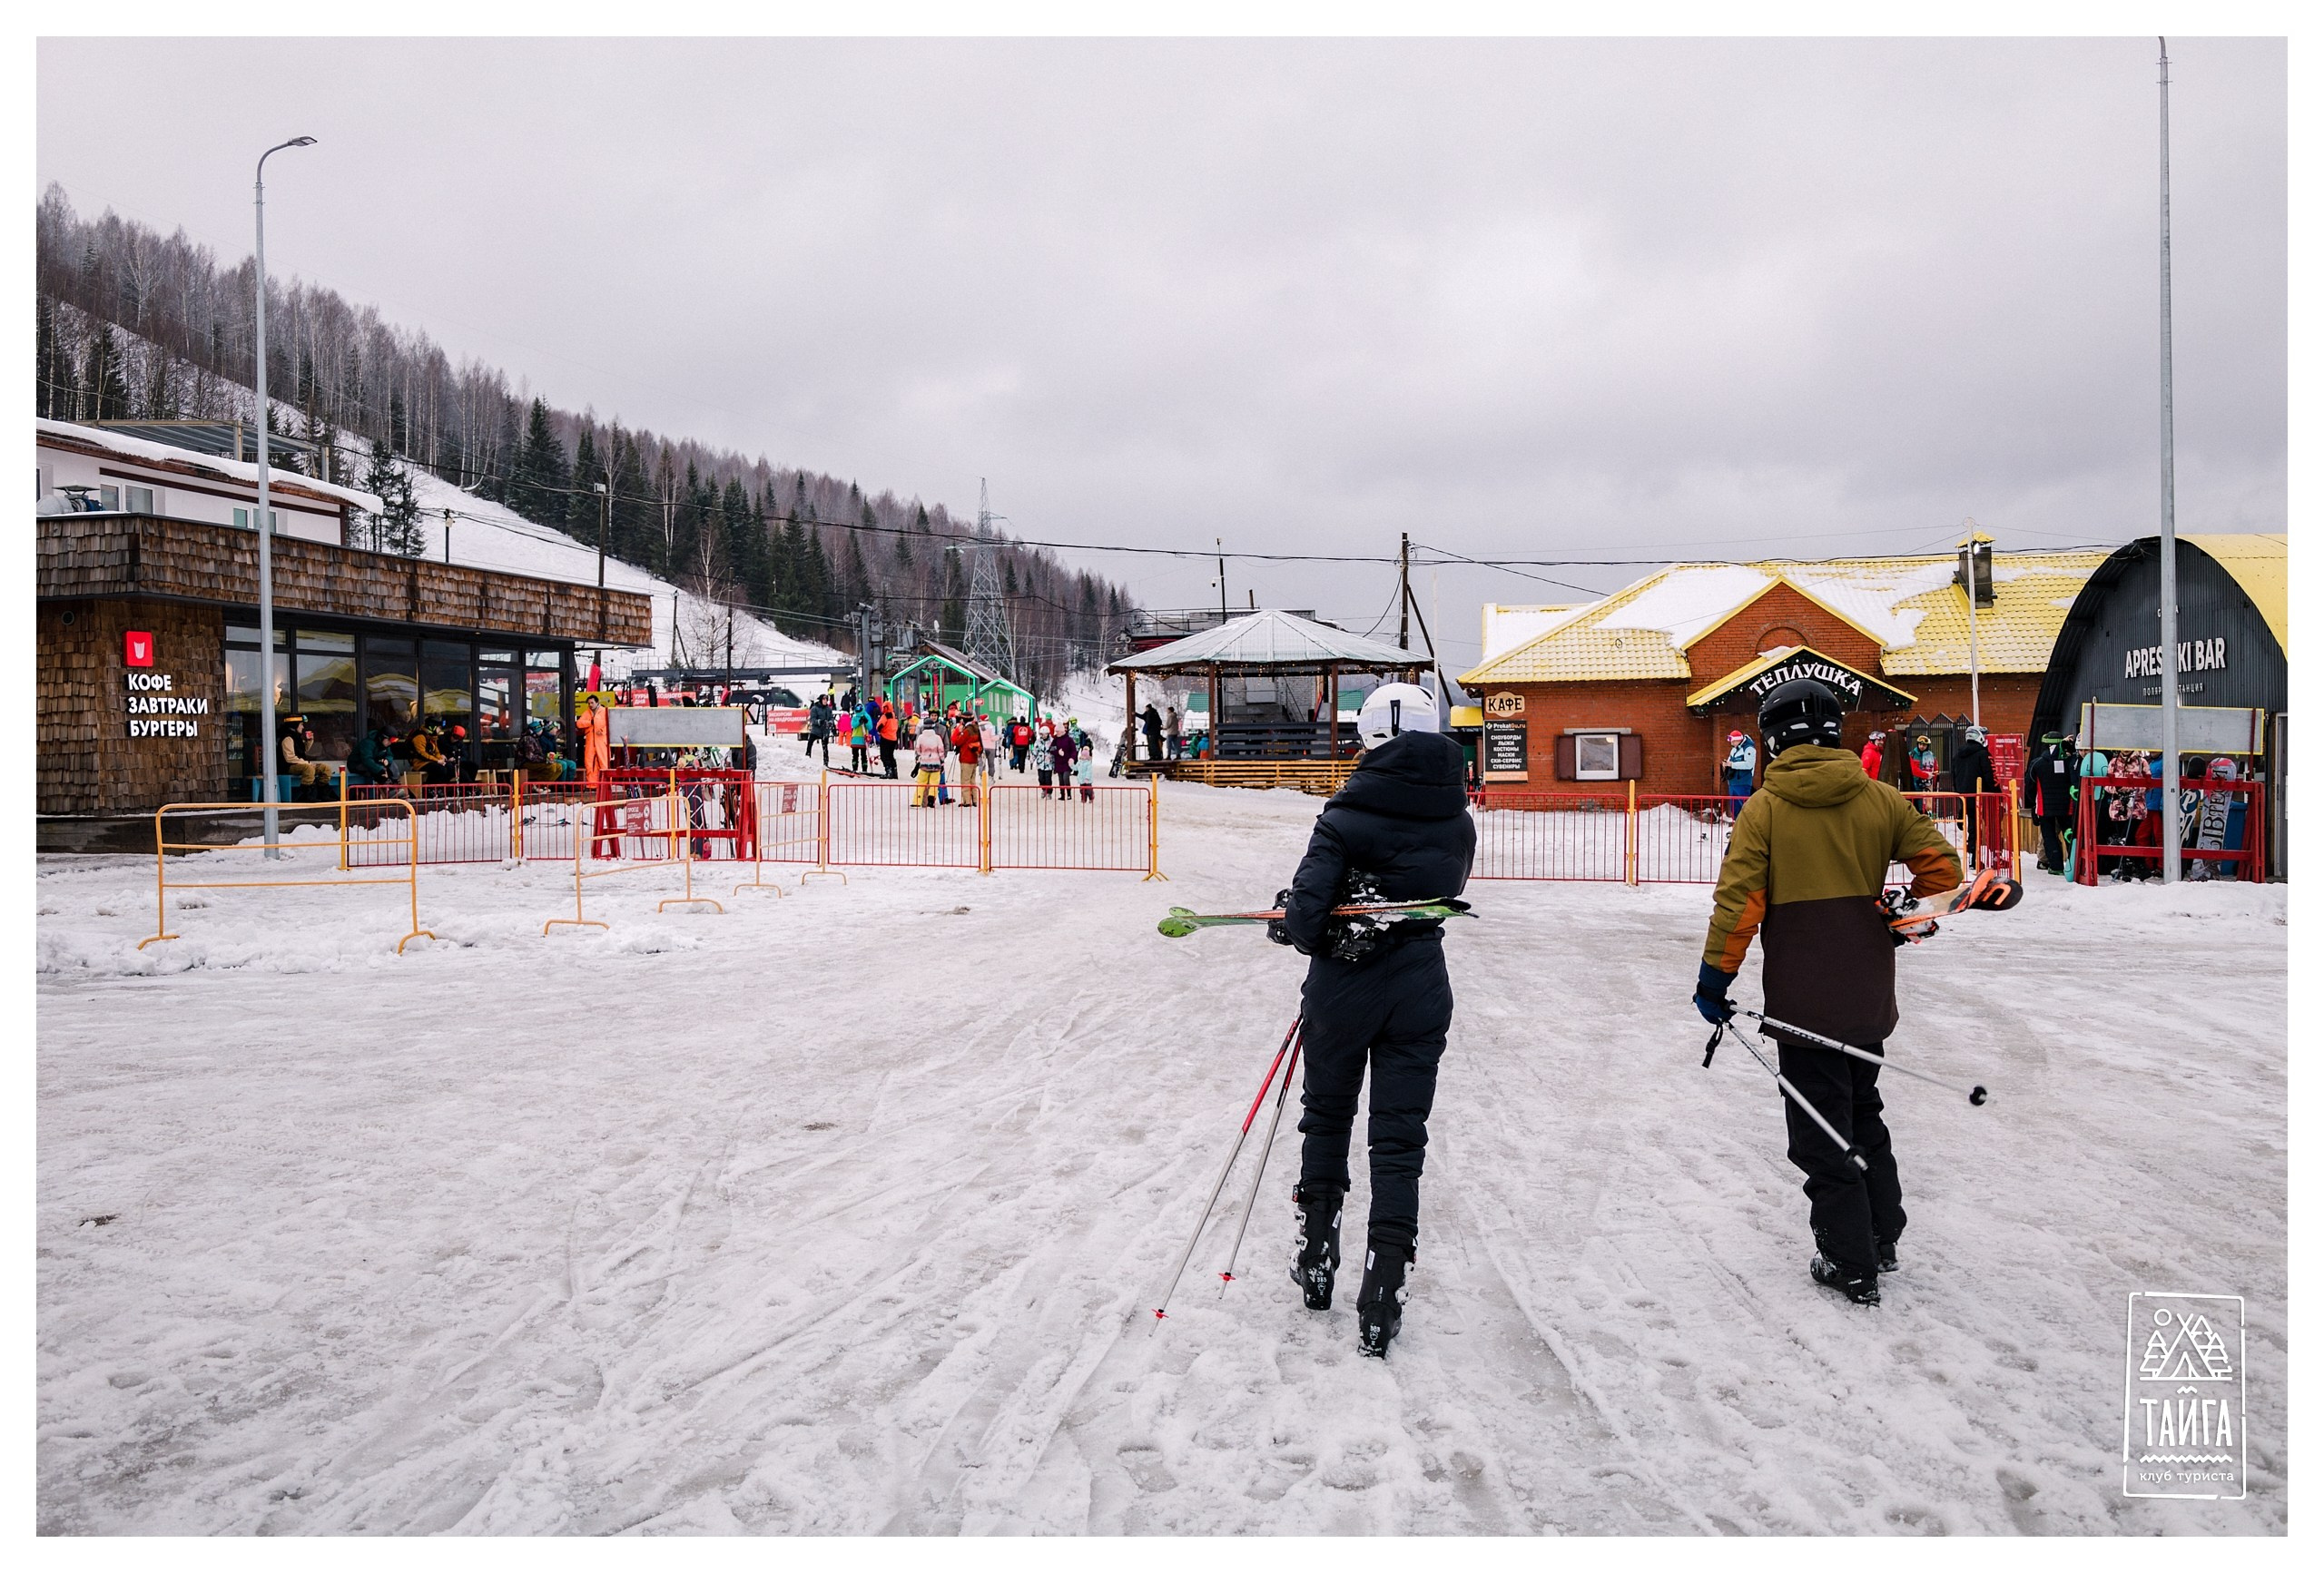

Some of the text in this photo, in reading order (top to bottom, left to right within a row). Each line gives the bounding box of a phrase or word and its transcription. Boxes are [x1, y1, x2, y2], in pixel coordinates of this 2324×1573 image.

[2177, 641, 2191, 673] KI
[2195, 637, 2226, 671] BAR
[128, 673, 172, 691] КОФЕ
[1748, 664, 1861, 696] ТЕПЛУШКА
[2178, 683, 2203, 693] ТАНЦИЯ
[128, 696, 208, 714] ЗАВТРАКИ
[1488, 697, 1522, 712] КАФЕ
[130, 720, 198, 737] БУРГЕРЫ
